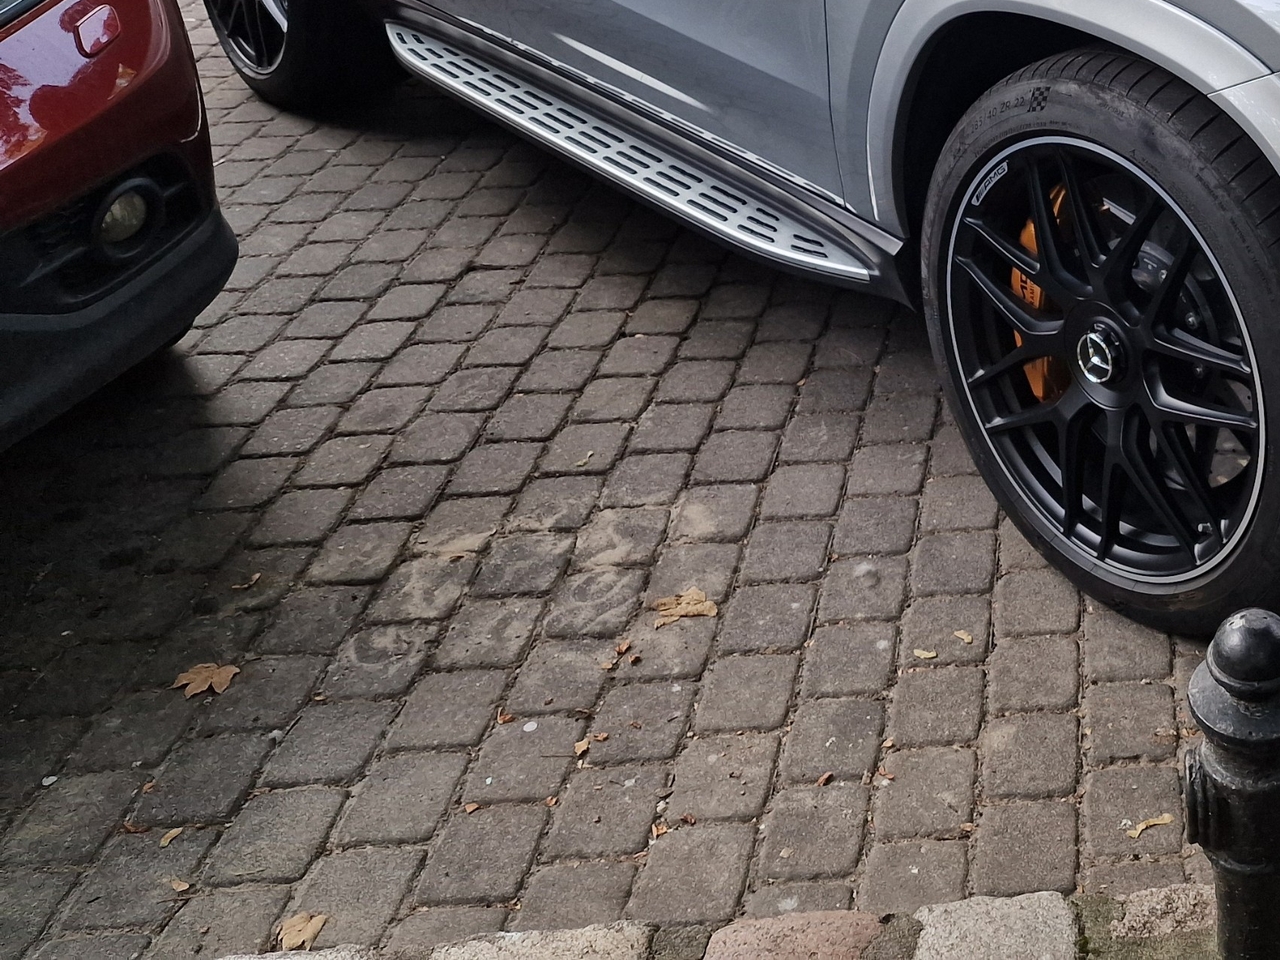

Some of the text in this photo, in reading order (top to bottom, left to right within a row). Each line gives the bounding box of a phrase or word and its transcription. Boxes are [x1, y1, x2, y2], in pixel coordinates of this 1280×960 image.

[1000, 100, 1011, 114] ZR
[1013, 96, 1026, 109] 22
[981, 166, 1006, 193] AMG
